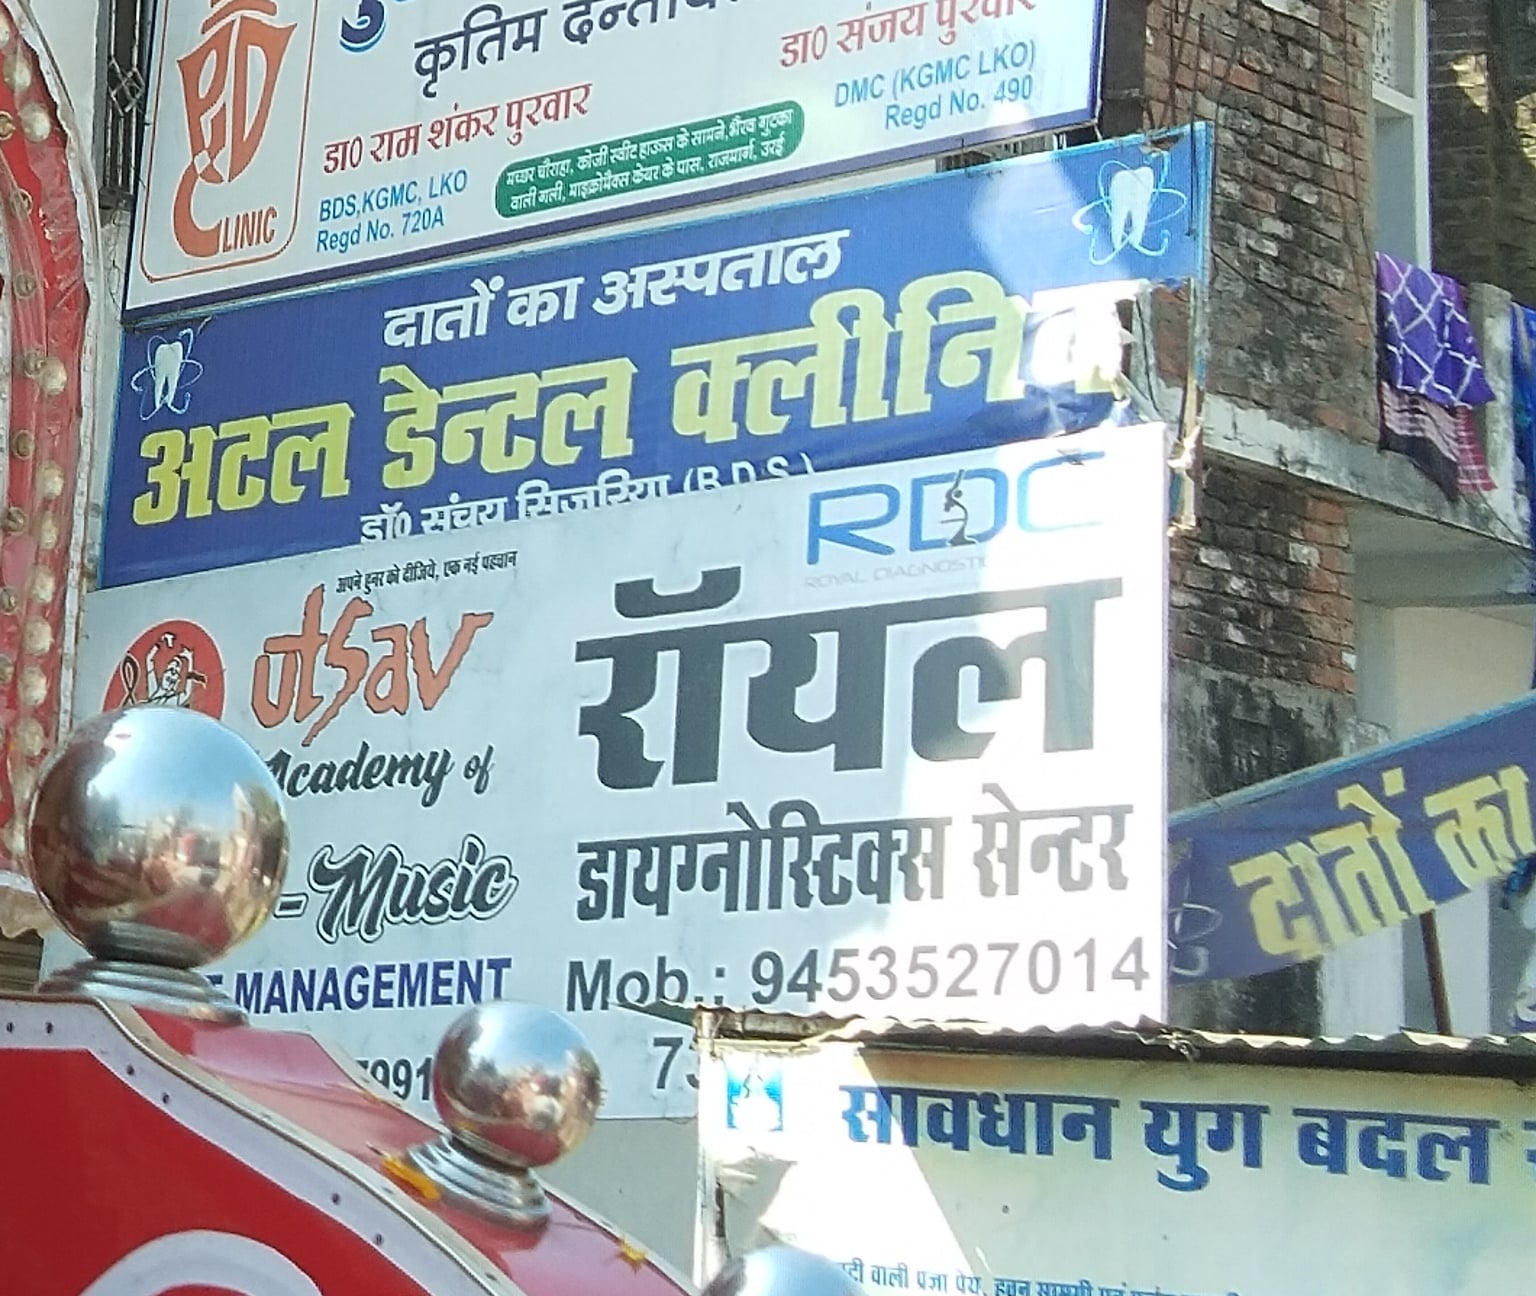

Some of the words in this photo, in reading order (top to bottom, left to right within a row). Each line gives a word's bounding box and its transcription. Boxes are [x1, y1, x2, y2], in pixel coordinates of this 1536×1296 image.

[836, 1, 929, 54] संजय
[834, 74, 885, 108] DMC
[892, 54, 971, 100] (KGMC
[978, 39, 1036, 75] LKO)
[885, 96, 942, 130] Regd
[949, 90, 985, 115] No.
[993, 74, 1034, 105] 490
[369, 123, 423, 163] राम
[427, 101, 500, 150] शंकर
[505, 83, 593, 147] पुरवार
[676, 127, 689, 150] के
[428, 168, 468, 199] LKO
[316, 220, 361, 254] Regd
[366, 219, 395, 243] No.
[402, 205, 445, 236] 720A
[382, 271, 504, 349] दातों
[505, 270, 586, 327] का
[591, 228, 853, 316] अस्पताल
[132, 401, 357, 528] अटल
[377, 362, 637, 491] डेन्टल
[806, 450, 1106, 566] RDC
[804, 569, 870, 590] ROYAL
[575, 565, 1123, 791] रॉयल
[260, 740, 456, 808] Academy
[463, 744, 495, 795] of
[575, 798, 953, 923] डायग्नोस्टिक्स
[971, 782, 1135, 899] सेन्टर
[1229, 766, 1437, 962] दातों
[1423, 764, 1536, 894] का
[234, 957, 513, 1015] MANAGEMENT
[750, 935, 1151, 1009] 9453527014
[839, 1085, 1120, 1161] सावधान
[1140, 1100, 1270, 1193] युग
[1293, 1107, 1502, 1186] बदल
[870, 1262, 909, 1289] वाली
